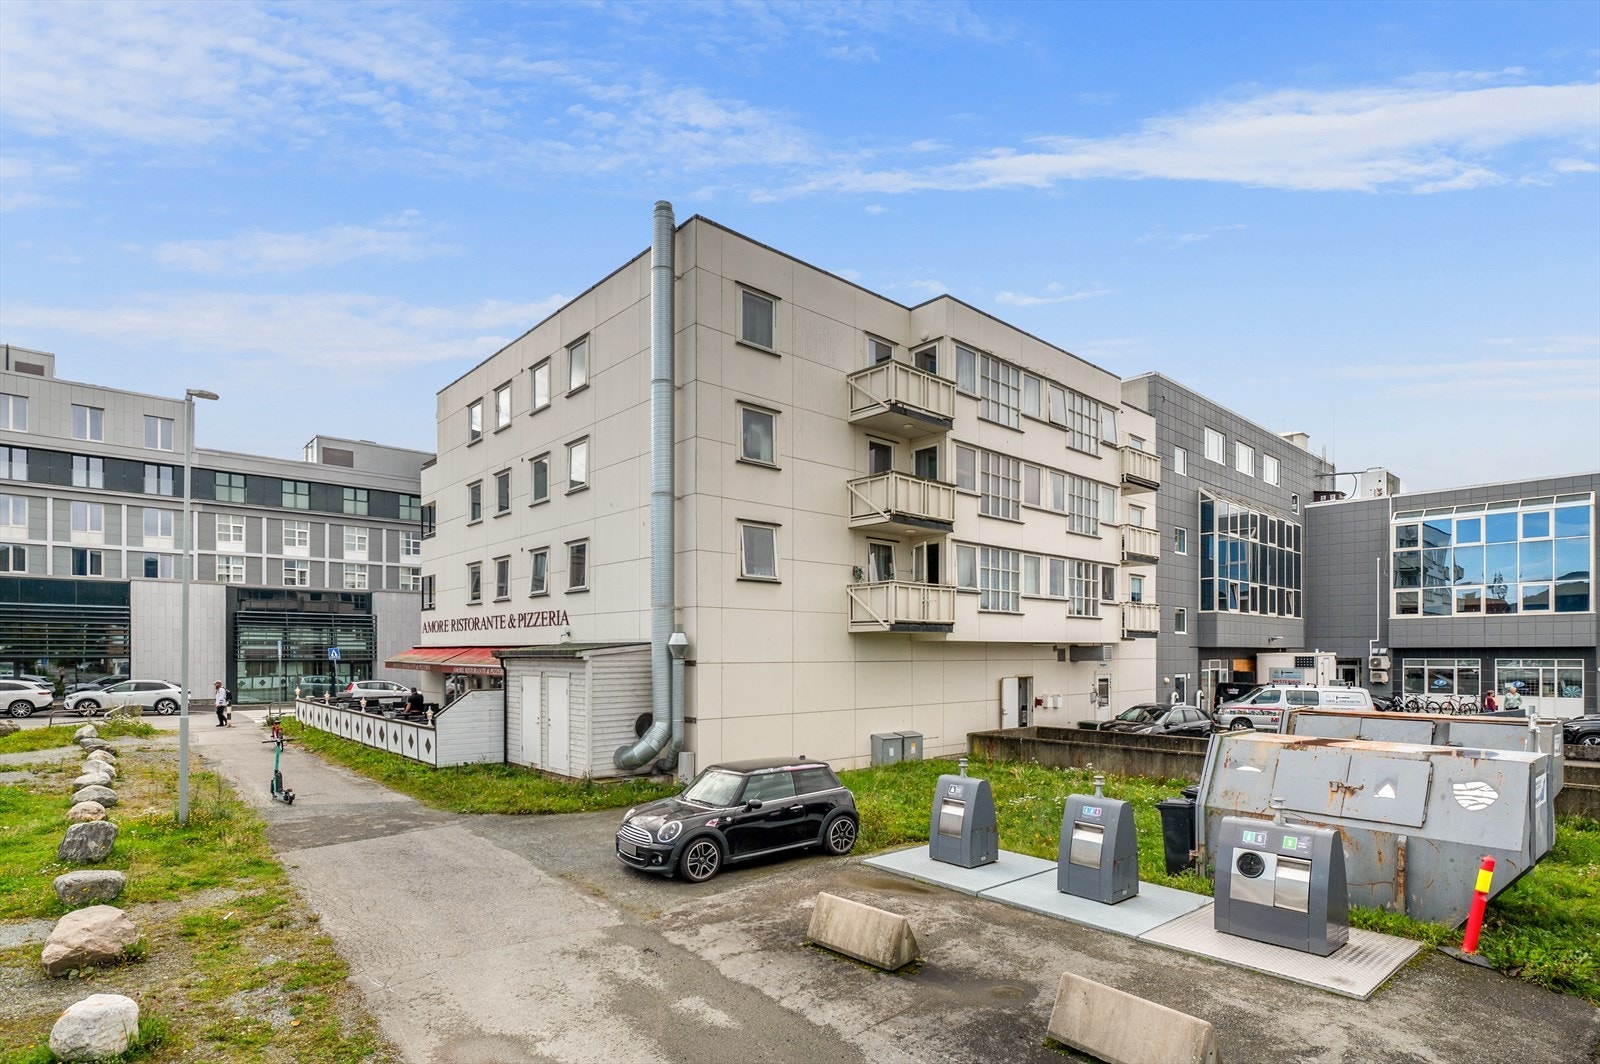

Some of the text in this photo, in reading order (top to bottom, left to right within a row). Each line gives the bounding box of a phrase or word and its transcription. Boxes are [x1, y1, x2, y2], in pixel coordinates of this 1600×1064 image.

[422, 609, 570, 634] AMORE RISTORANTE & PIZZERIA
